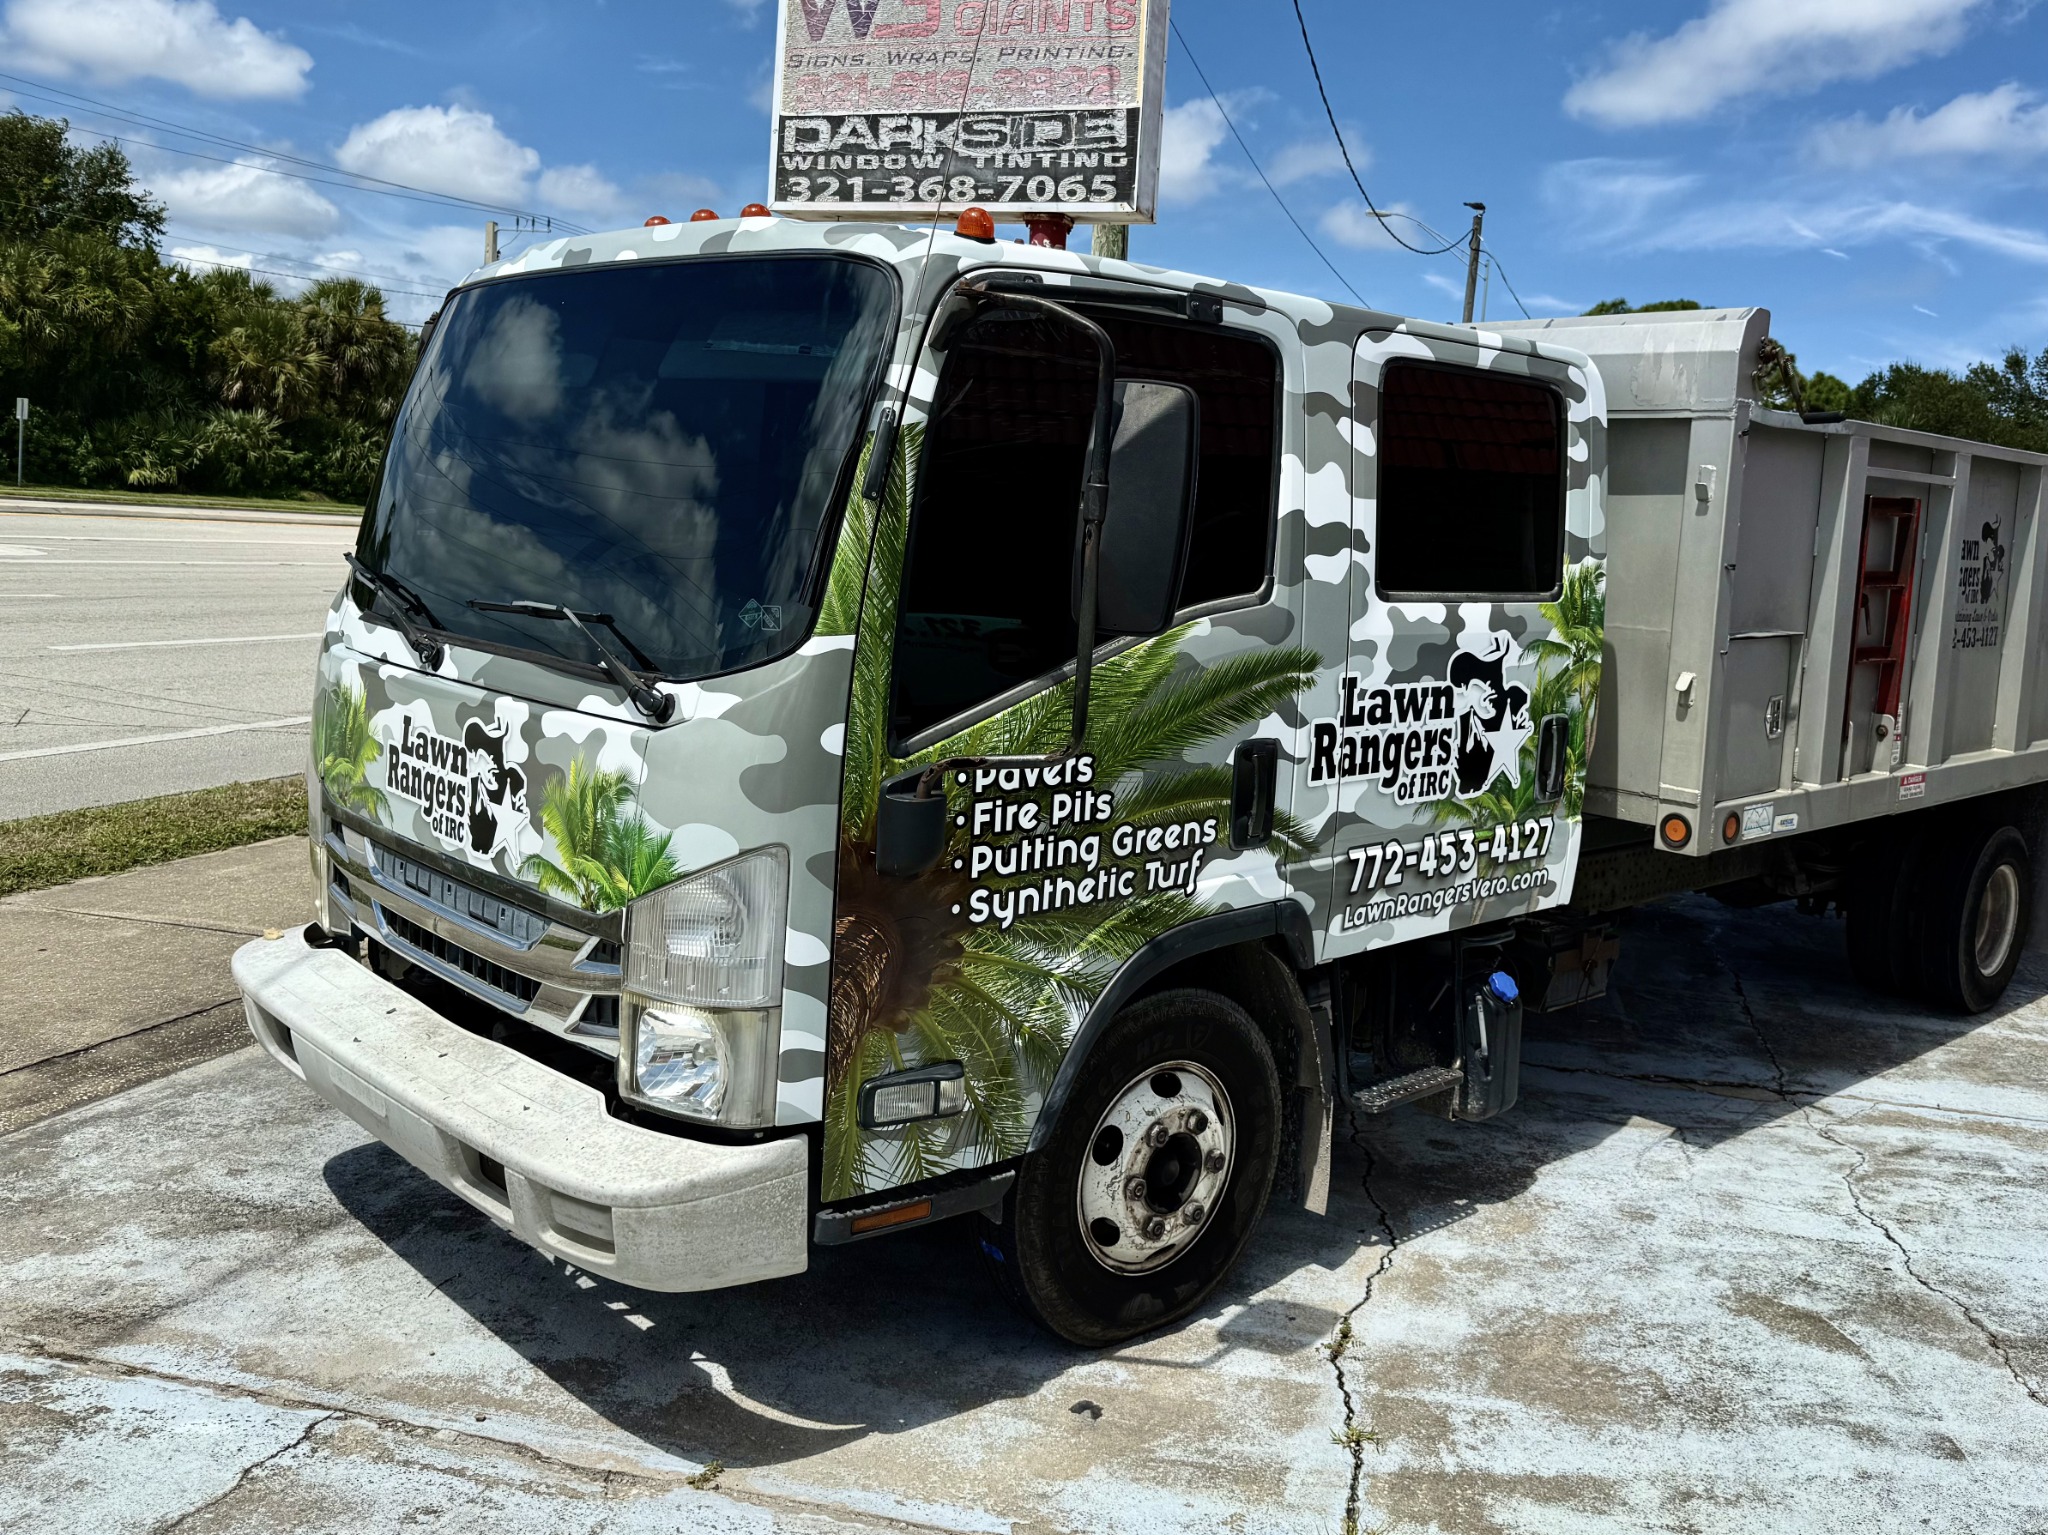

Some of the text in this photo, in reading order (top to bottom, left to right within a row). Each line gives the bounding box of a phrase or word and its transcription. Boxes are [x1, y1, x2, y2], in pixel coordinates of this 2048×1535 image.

[953, 0, 1137, 36] GIANTS
[997, 45, 1134, 62] PRINTING.
[783, 110, 1127, 155] DARKSIDE
[781, 151, 1129, 171] WINDOW TINTING
[786, 174, 1118, 203] 321-368-7065
[1339, 676, 1455, 728] Lawn
[401, 714, 468, 776] Lawn
[1310, 722, 1453, 789] Rangers
[387, 744, 466, 818] Rangers
[974, 756, 1094, 794] Pavers
[1397, 771, 1450, 801] of IRC
[432, 814, 464, 844] of IRC
[973, 790, 1112, 836] Fire Pits
[970, 817, 1217, 879] Putting Greens
[1348, 817, 1554, 893] 772-453-4127
[968, 848, 1204, 929] Synthetic Turf
[1343, 867, 1548, 929] LawnRangersVero.com
